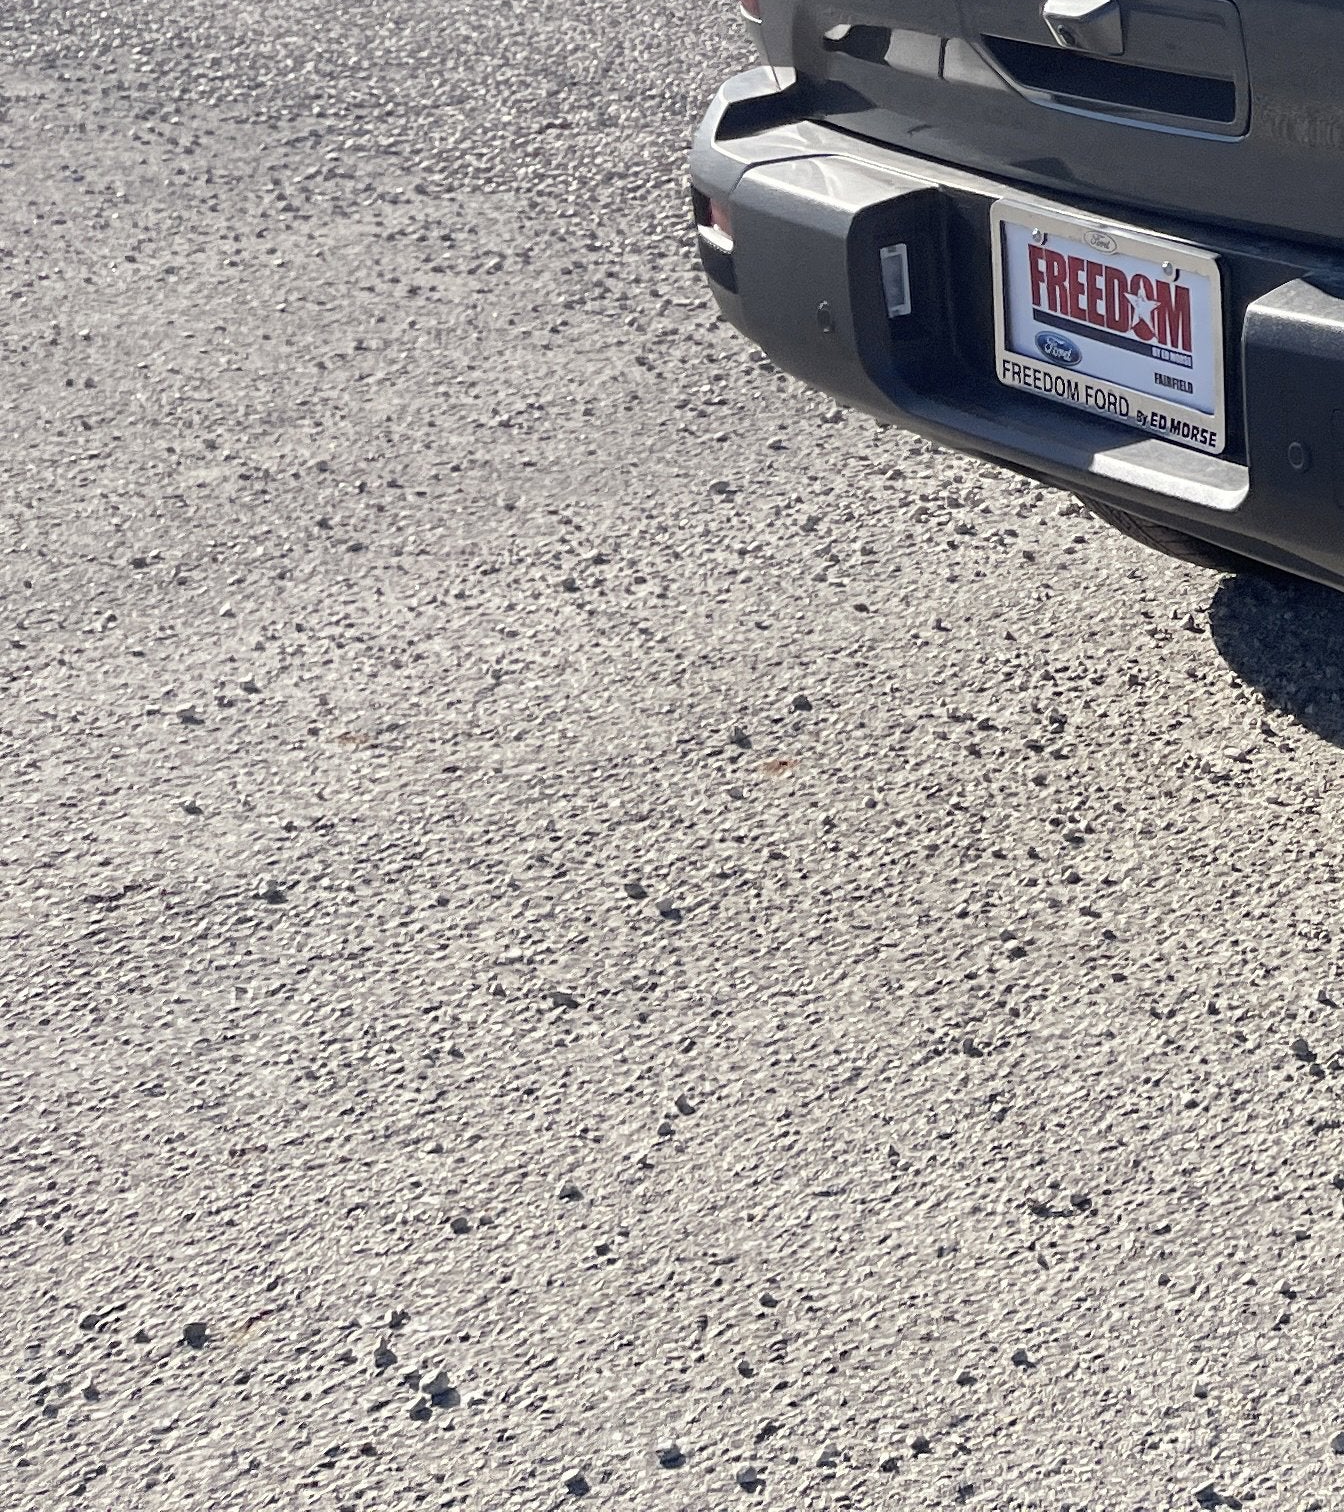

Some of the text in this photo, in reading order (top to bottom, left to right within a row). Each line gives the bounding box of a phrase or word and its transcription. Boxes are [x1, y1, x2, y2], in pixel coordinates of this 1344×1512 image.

[1090, 233, 1110, 250] Ford
[1028, 243, 1193, 353] FREEDOM
[1044, 337, 1073, 362] Ford
[1154, 372, 1193, 394] FAIRFIELD
[1002, 359, 1080, 402] FREEDOM
[1085, 385, 1130, 418] FORD
[1150, 411, 1167, 430] ED
[1169, 417, 1217, 448] MORSE
